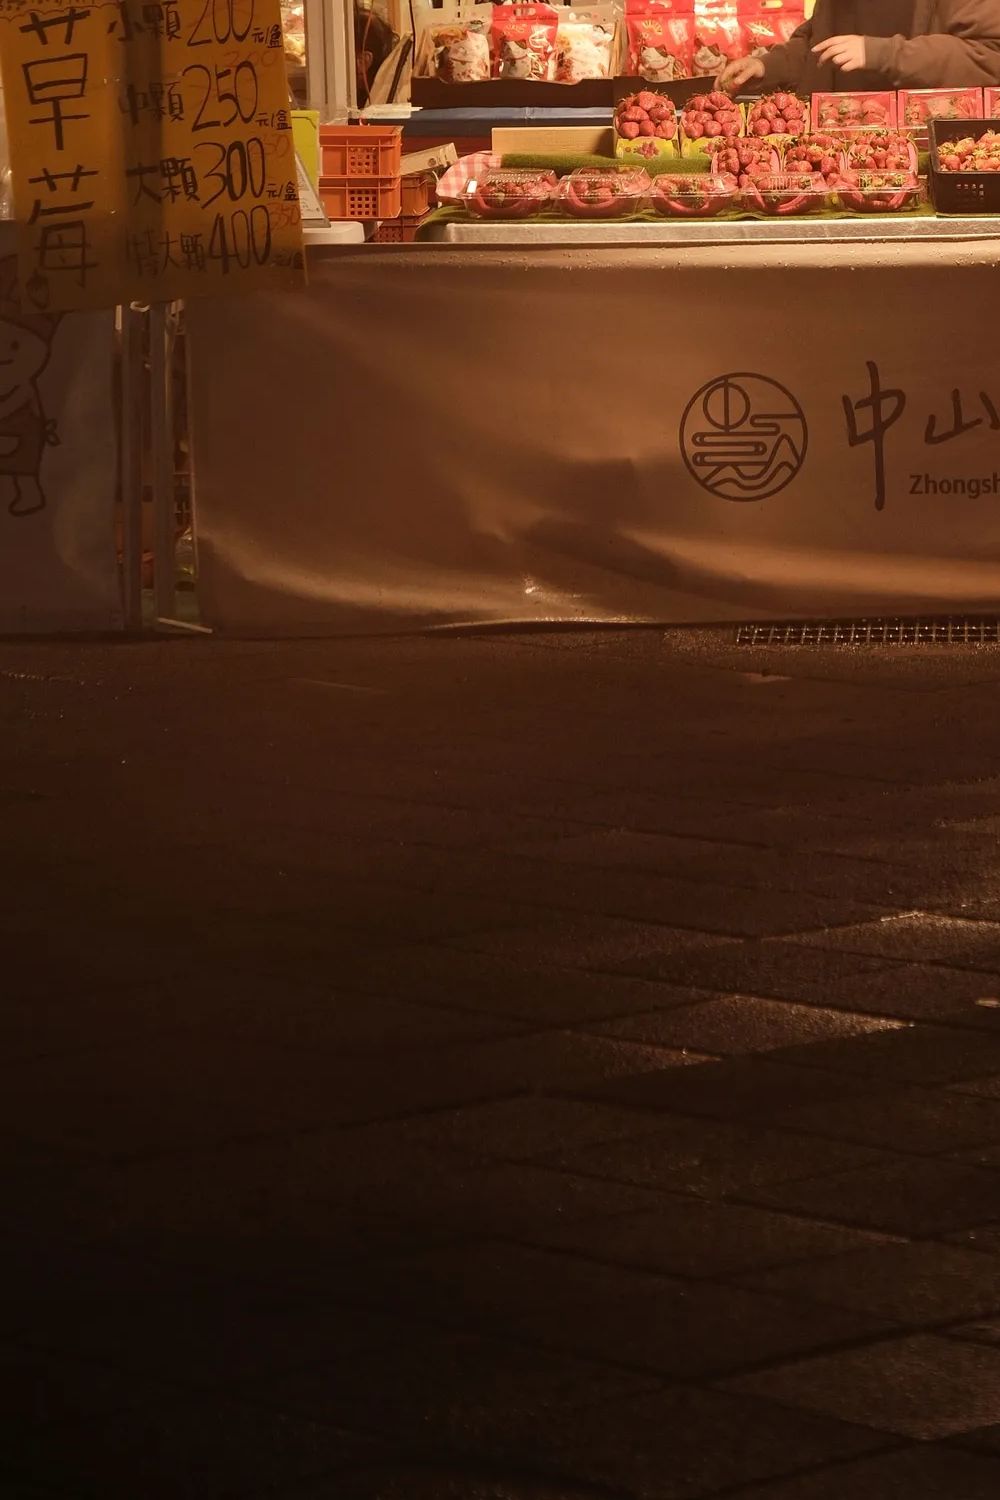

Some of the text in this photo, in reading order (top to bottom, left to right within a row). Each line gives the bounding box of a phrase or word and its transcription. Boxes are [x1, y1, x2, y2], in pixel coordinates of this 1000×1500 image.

[182, 61, 258, 132] 250
[193, 137, 265, 210] 300
[210, 205, 271, 274] 400
